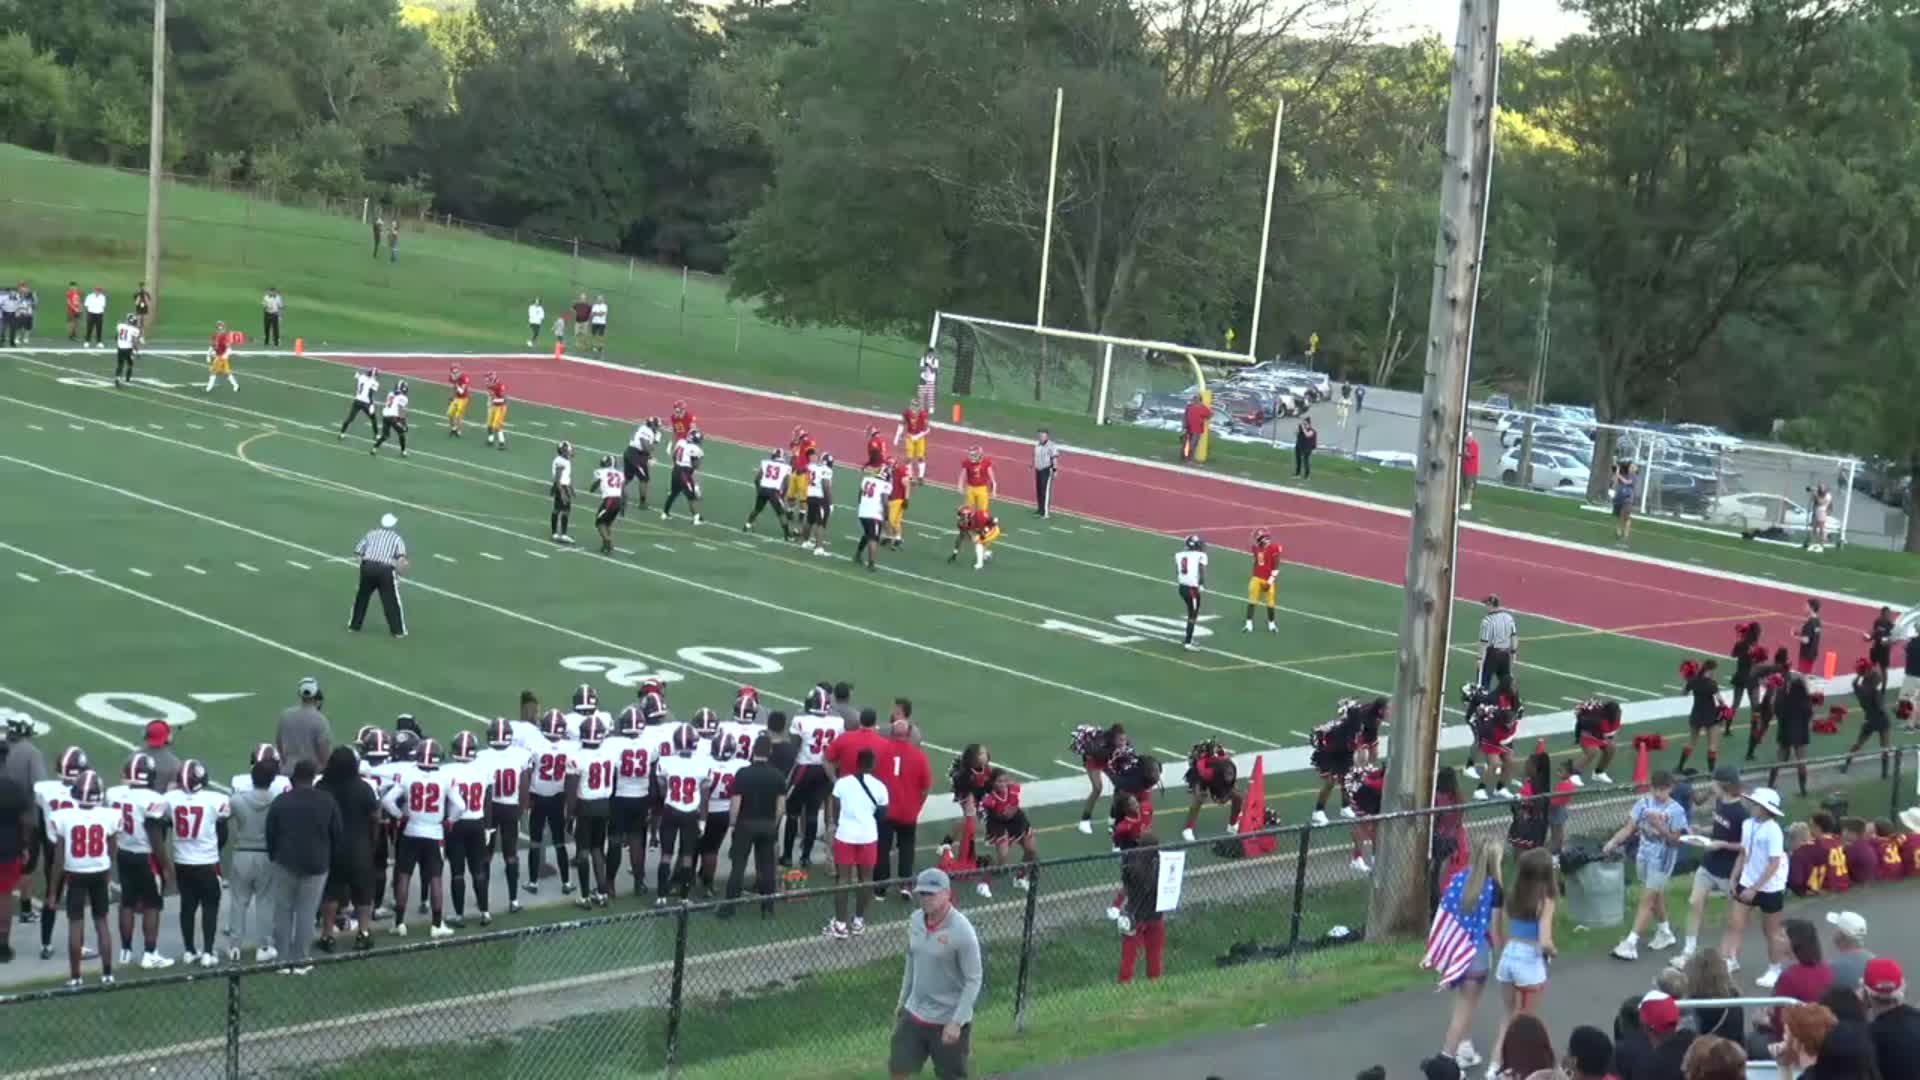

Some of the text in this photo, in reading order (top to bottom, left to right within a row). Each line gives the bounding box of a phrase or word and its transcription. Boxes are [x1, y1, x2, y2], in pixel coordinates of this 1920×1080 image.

[587, 760, 611, 790] 81
[892, 756, 902, 777] 1
[409, 781, 439, 813] 82
[494, 768, 516, 798] 10
[174, 806, 204, 839] 67
[70, 824, 104, 859] 88
